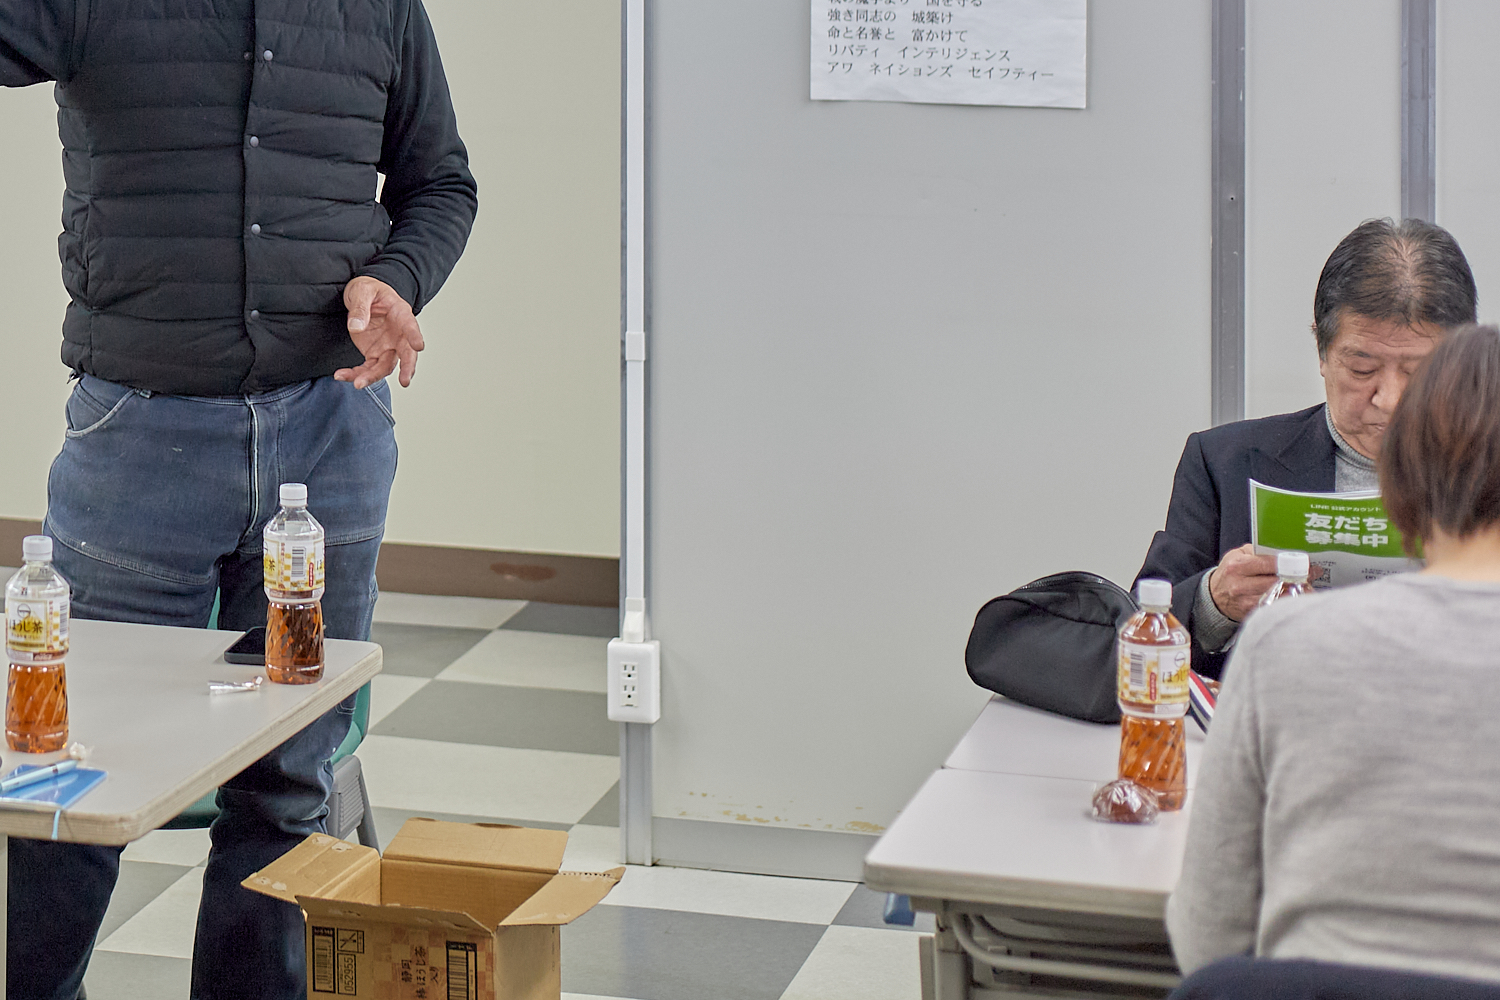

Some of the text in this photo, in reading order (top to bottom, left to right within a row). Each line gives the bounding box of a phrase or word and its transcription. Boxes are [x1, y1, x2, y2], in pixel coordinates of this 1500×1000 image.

[827, 7, 897, 24] 強き同志の
[898, 45, 1011, 62] インテリジェンス
[827, 61, 1054, 80] アワ ネイションズ セイフティー
[1304, 512, 1388, 531] 友だち
[1304, 529, 1389, 547] 募集中
[9, 619, 43, 634] ほうじ茶
[344, 957, 354, 992] 052955
[429, 965, 439, 985] 入り
